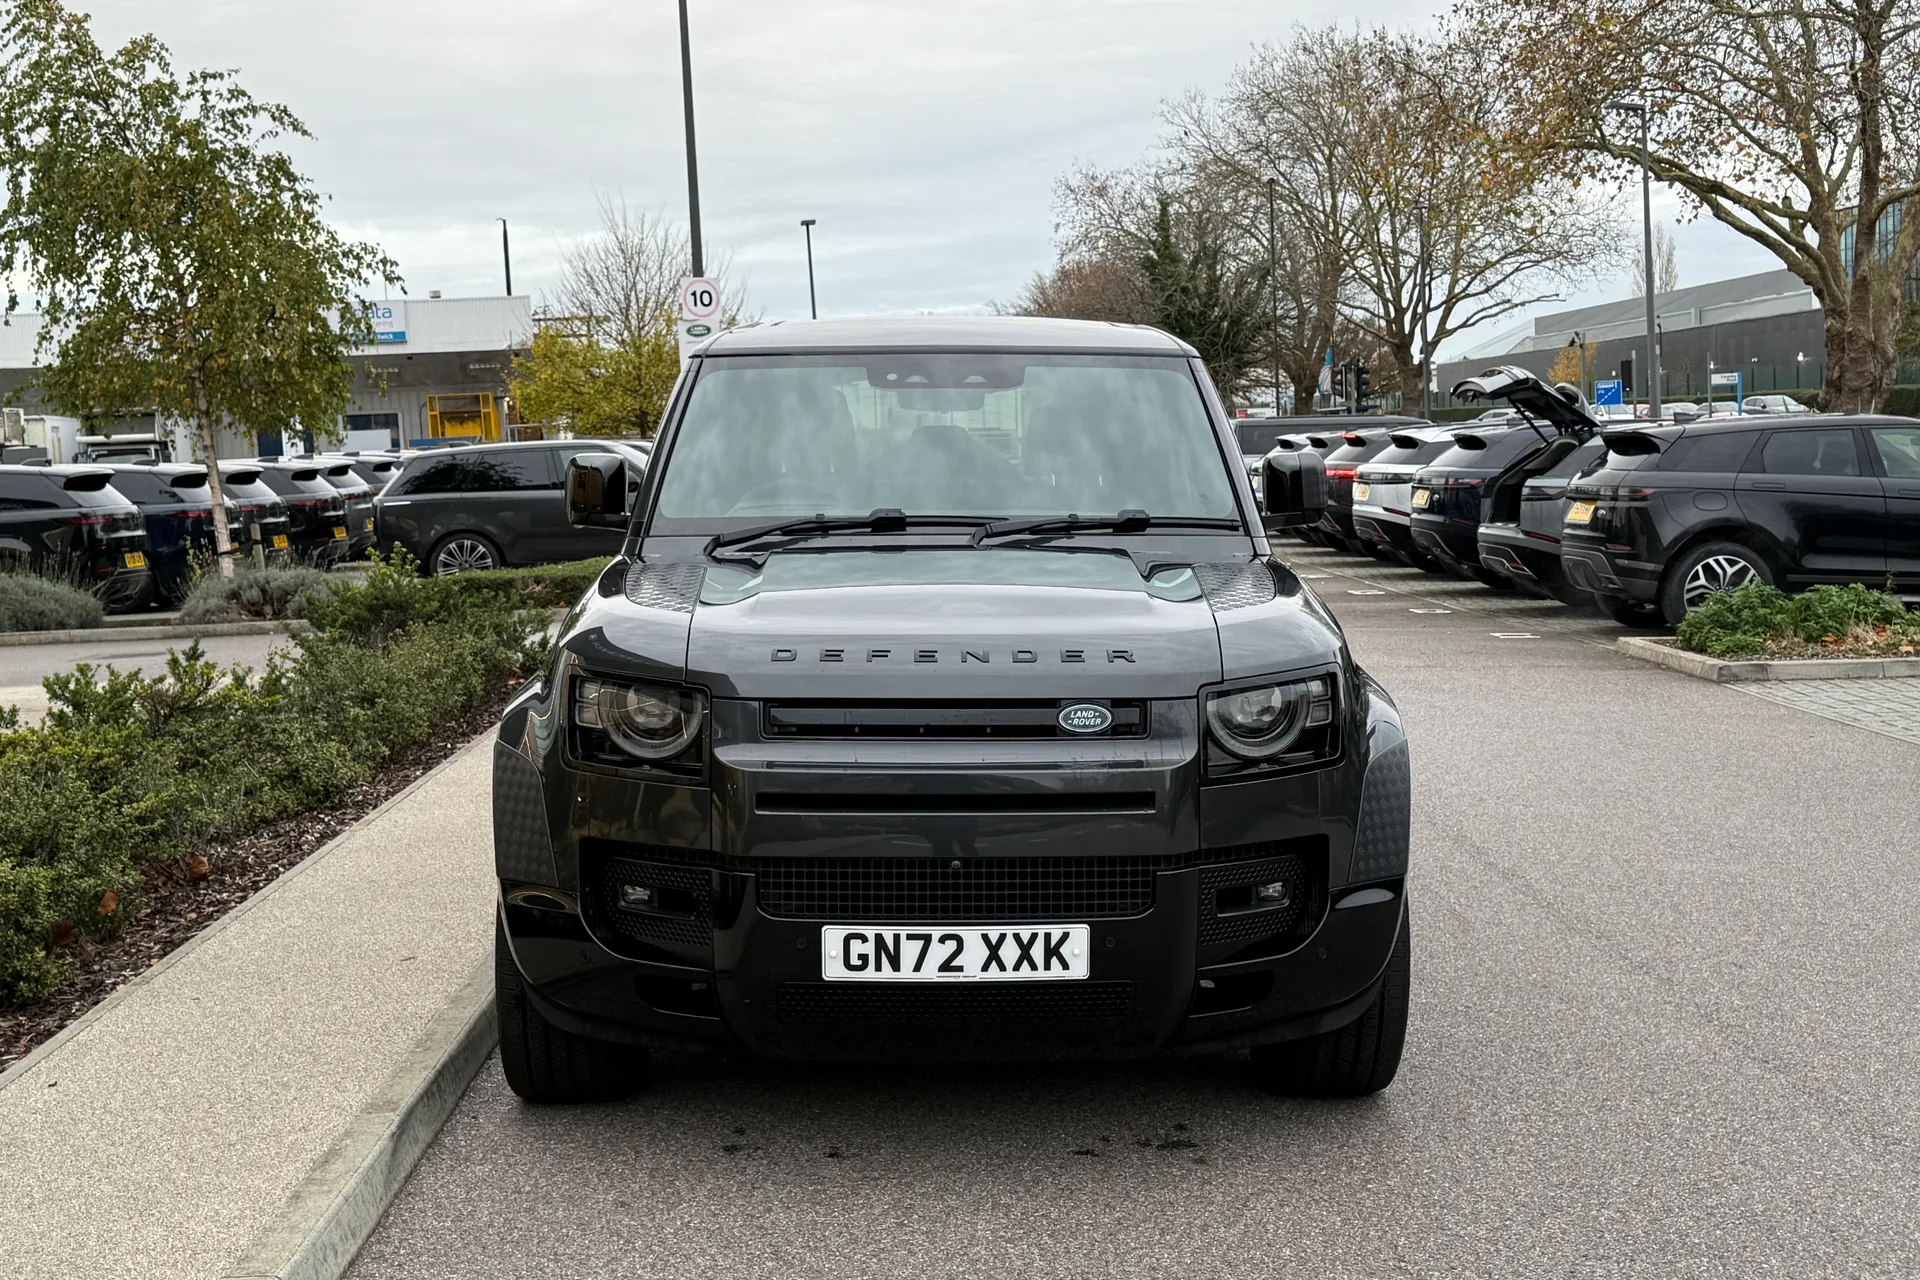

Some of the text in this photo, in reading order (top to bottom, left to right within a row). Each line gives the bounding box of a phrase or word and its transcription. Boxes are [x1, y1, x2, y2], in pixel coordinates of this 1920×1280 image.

[690, 290, 713, 307] 10
[771, 648, 1136, 663] DEFENDER
[842, 931, 1070, 973] GN72 XXK
